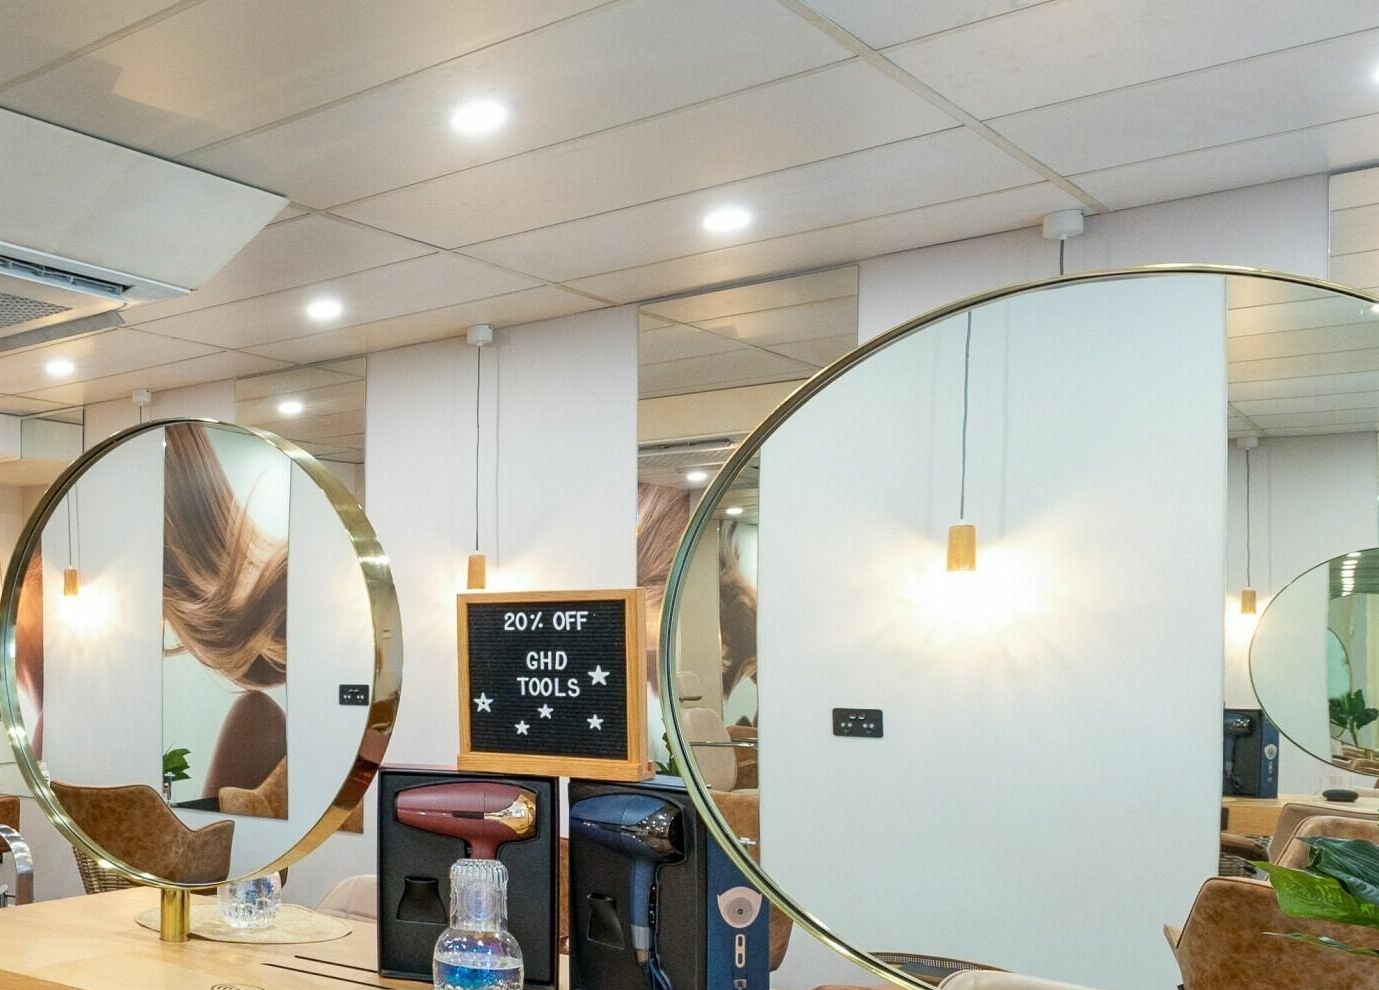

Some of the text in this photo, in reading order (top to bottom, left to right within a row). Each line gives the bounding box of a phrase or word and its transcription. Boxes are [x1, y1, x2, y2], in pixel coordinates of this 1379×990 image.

[504, 611, 589, 631] 20% OFF
[526, 650, 568, 671] GHD
[516, 677, 581, 697] TOOLS
